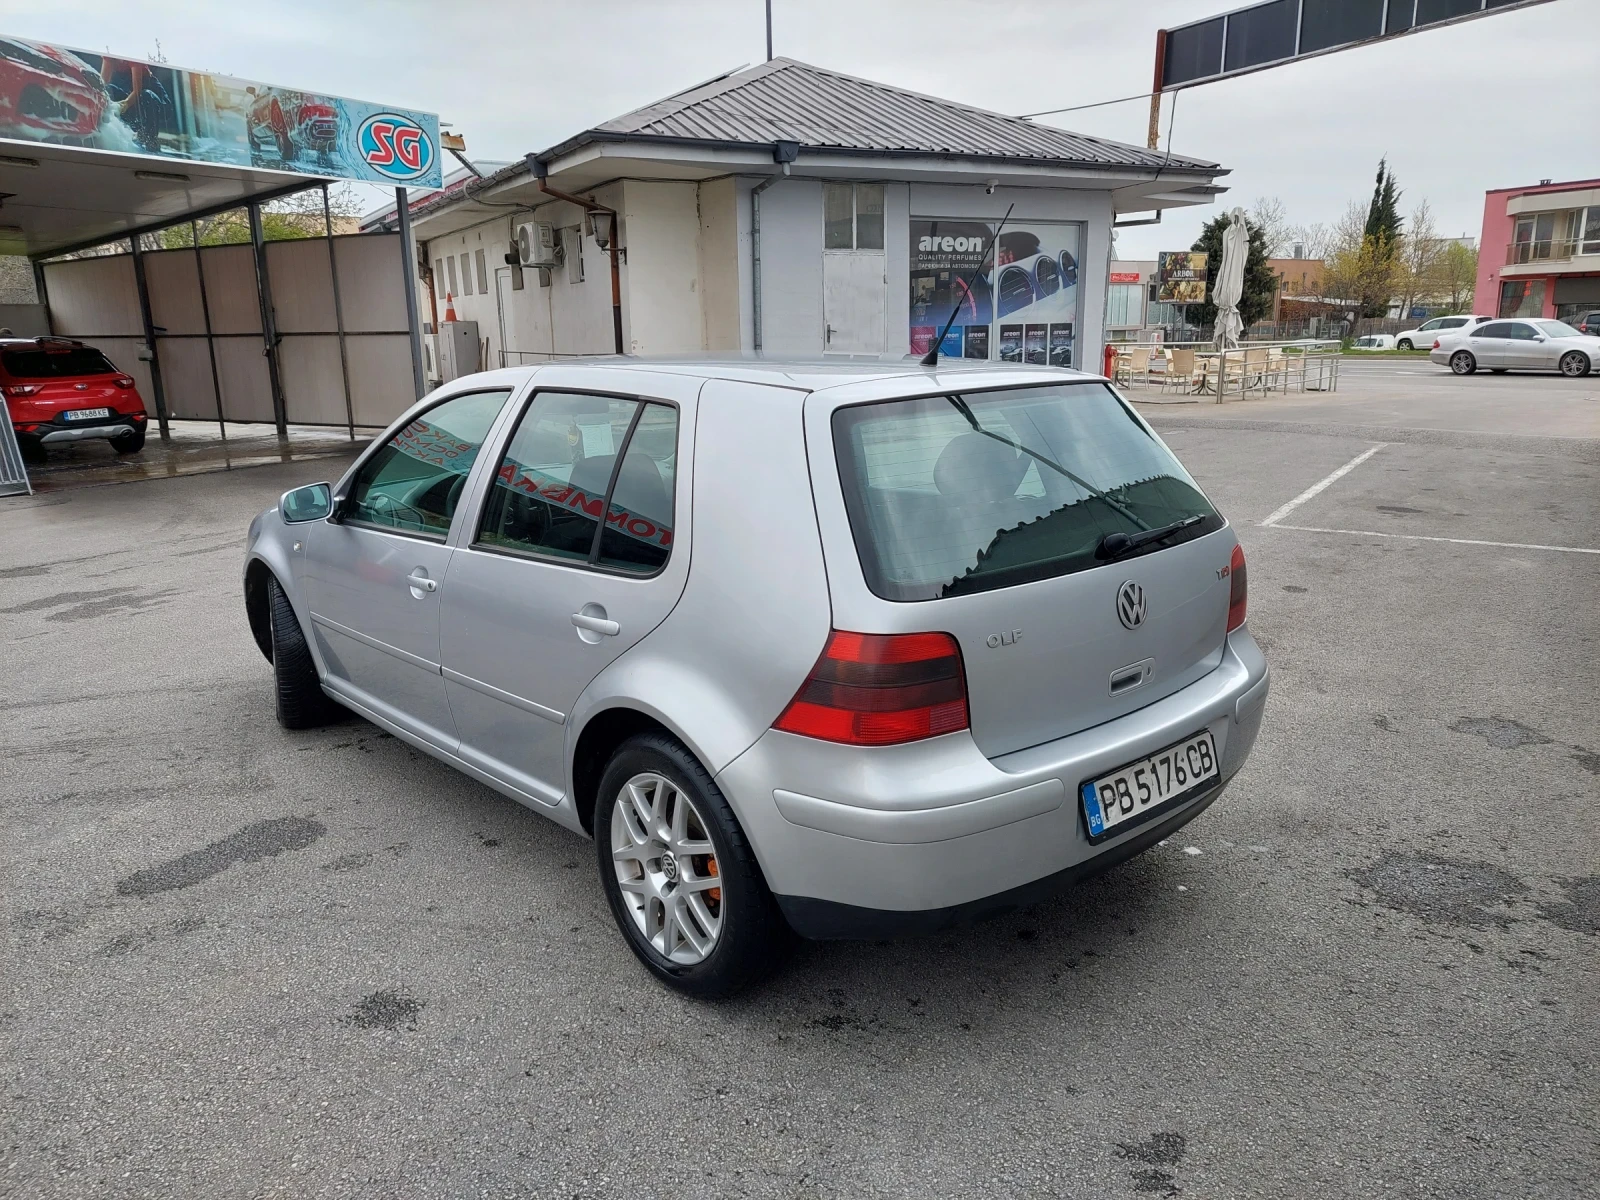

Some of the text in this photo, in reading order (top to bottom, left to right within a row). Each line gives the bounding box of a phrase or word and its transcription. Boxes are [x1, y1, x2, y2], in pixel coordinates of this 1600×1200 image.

[367, 121, 422, 170] SG
[919, 236, 982, 251] areon
[1172, 270, 1195, 278] ARBOR
[69, 411, 79, 419] PB
[986, 628, 1022, 649] OLF
[1099, 739, 1213, 823] PB 5176 CB
[1090, 814, 1101, 827] BG
